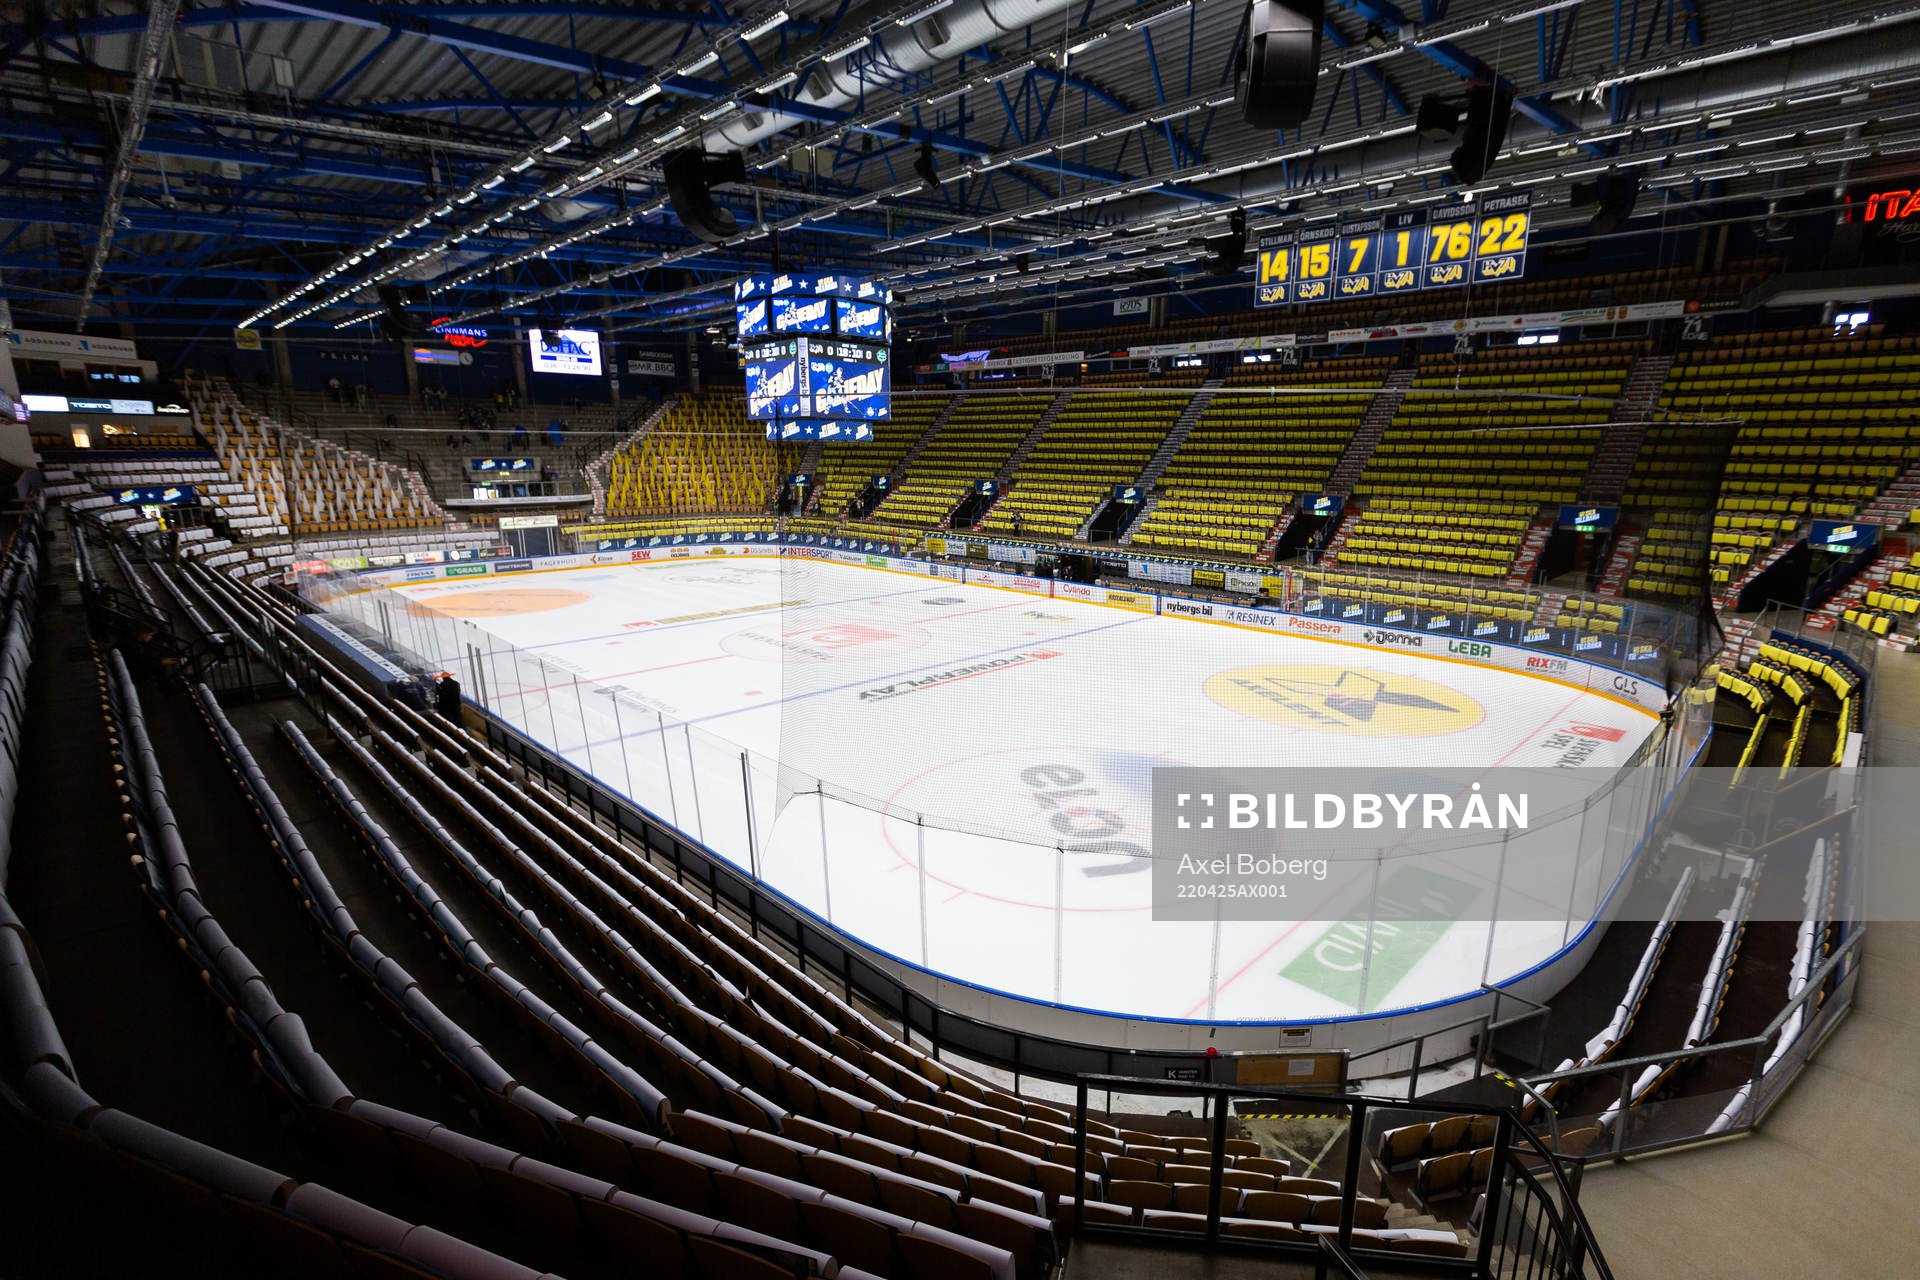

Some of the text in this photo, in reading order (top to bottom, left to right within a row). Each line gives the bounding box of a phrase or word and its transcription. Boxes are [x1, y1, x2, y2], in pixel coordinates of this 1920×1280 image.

[1484, 194, 1530, 211] PETRASEK
[1433, 203, 1476, 219] DAVIDSSON
[1342, 221, 1380, 235] GUSTAFSSON
[1398, 214, 1414, 226] LIV
[1260, 233, 1293, 247] STILLMAN
[1430, 221, 1472, 262] 76
[1478, 213, 1528, 255] 22
[1348, 238, 1369, 273] 7
[1396, 230, 1410, 266] 1
[1260, 249, 1289, 284] 14
[1300, 243, 1331, 279] 15
[434, 326, 488, 337] LINNMANS
[799, 357, 809, 389] nybergs
[632, 550, 651, 559] SEW
[787, 547, 833, 559] INTERSPORT
[540, 558, 577, 567] FAGERHULT
[1063, 584, 1091, 596] Cylinda
[1166, 601, 1213, 617] nybergs bil
[1236, 611, 1277, 627] RESINEX
[1289, 616, 1342, 634] Passera
[1448, 639, 1492, 656] LEBA
[1613, 675, 1638, 696] GLS
[1168, 1069, 1177, 1079] K
